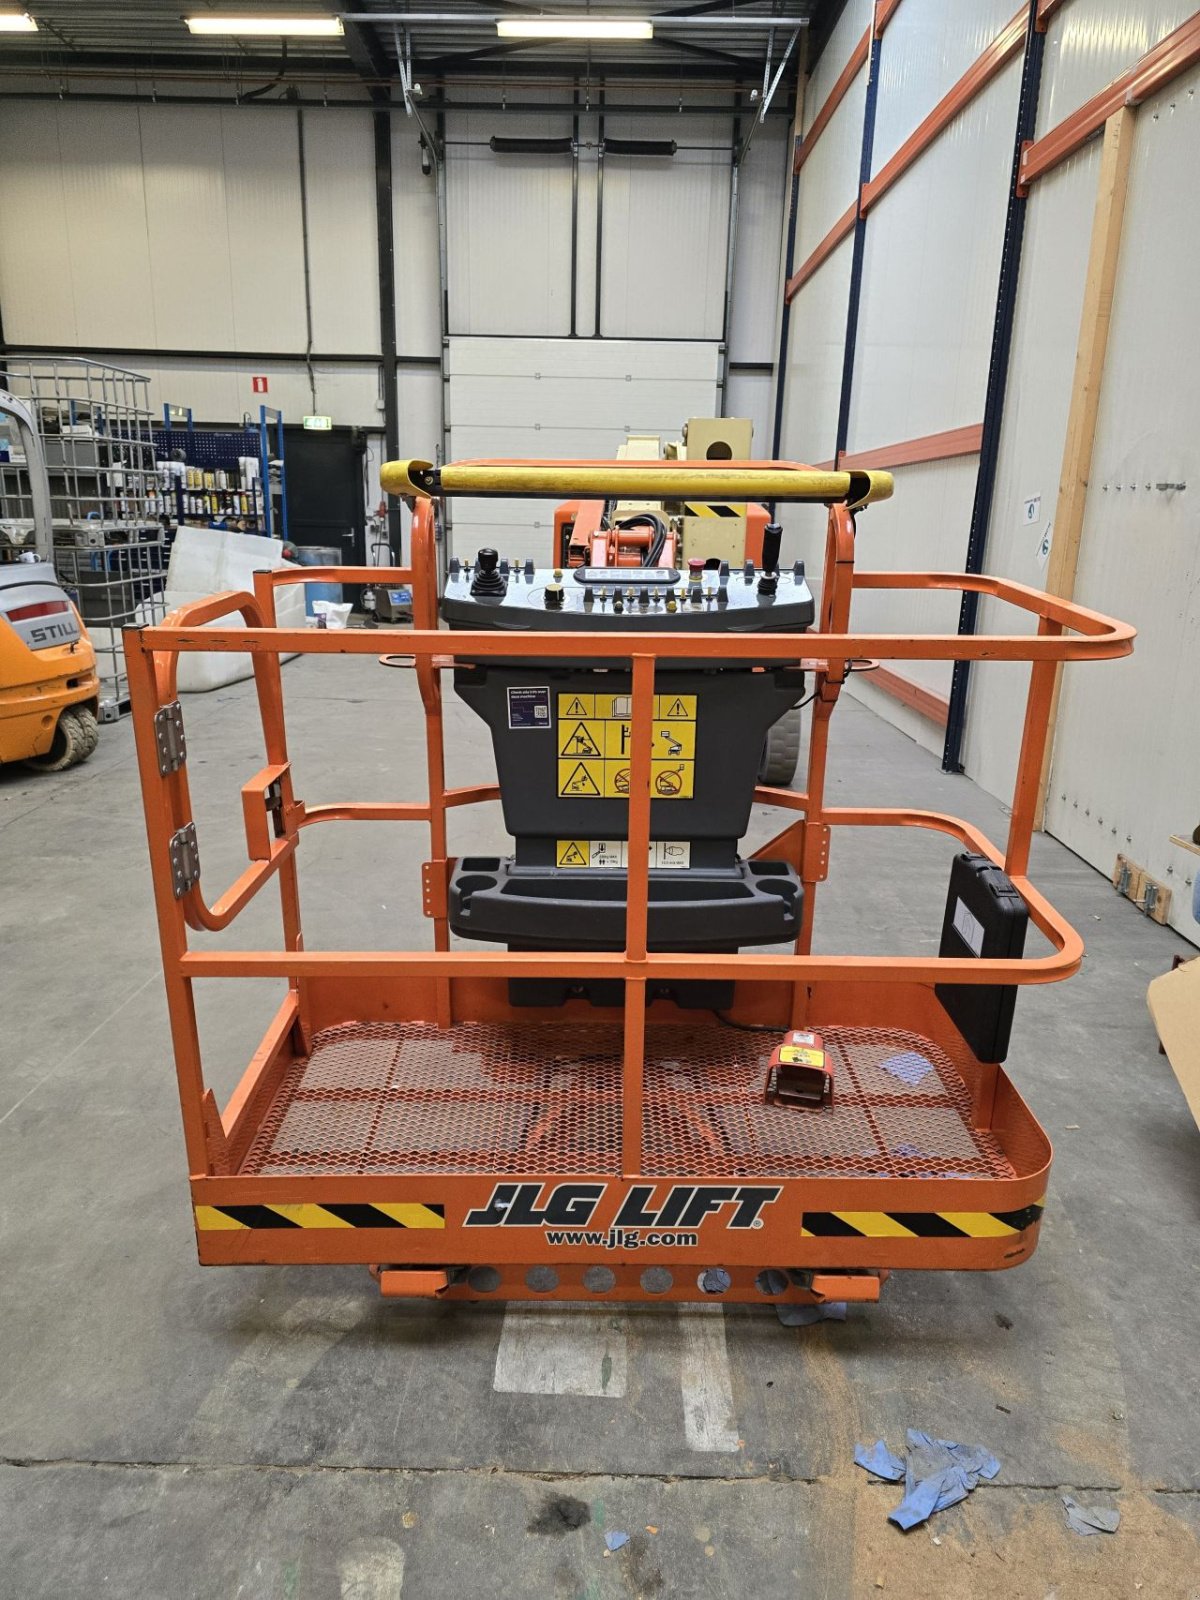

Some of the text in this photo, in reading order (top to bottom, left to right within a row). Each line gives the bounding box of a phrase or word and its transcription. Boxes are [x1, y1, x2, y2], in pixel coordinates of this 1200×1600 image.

[30, 622, 79, 643] STILL
[462, 1182, 784, 1230] JLG LIFT
[545, 1229, 698, 1250] www.jlg.com
